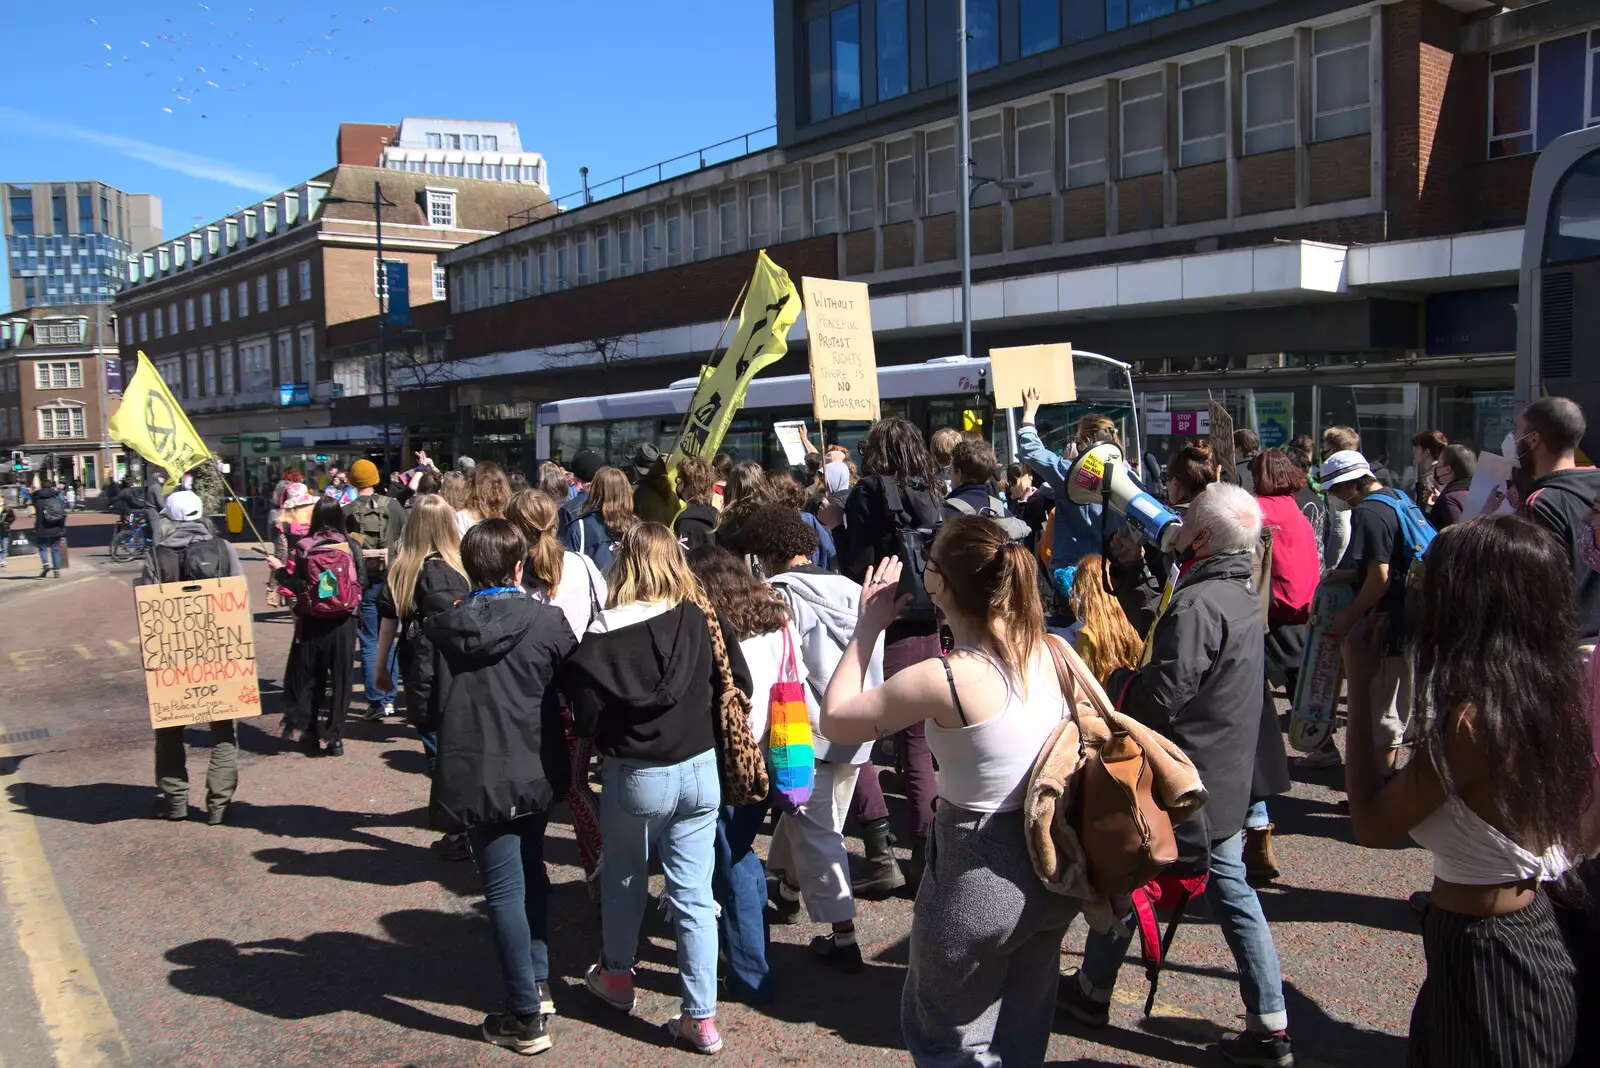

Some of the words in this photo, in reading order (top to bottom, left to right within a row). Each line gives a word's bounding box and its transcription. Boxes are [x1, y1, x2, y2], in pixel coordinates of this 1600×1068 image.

[813, 291, 854, 310] WITHOUT
[818, 313, 859, 330] PEACEFUL
[818, 333, 851, 348] PROTEST
[832, 350, 862, 367] RIGHTS
[820, 367, 847, 379] THERE
[838, 382, 851, 392] NO
[822, 394, 872, 410] DEMOCRACY
[1178, 421, 1191, 431] BP
[1090, 467, 1101, 476] NHS
[138, 594, 211, 622] PROTEST
[210, 591, 248, 613] NOW
[143, 620, 164, 637] SO
[170, 613, 217, 635] YOUR
[144, 625, 243, 655] CHILDREN
[145, 652, 178, 671] CAN
[184, 642, 255, 665] PROTEST
[150, 659, 255, 688] TOMORROW
[183, 685, 218, 700] STOP
[151, 702, 170, 715] The
